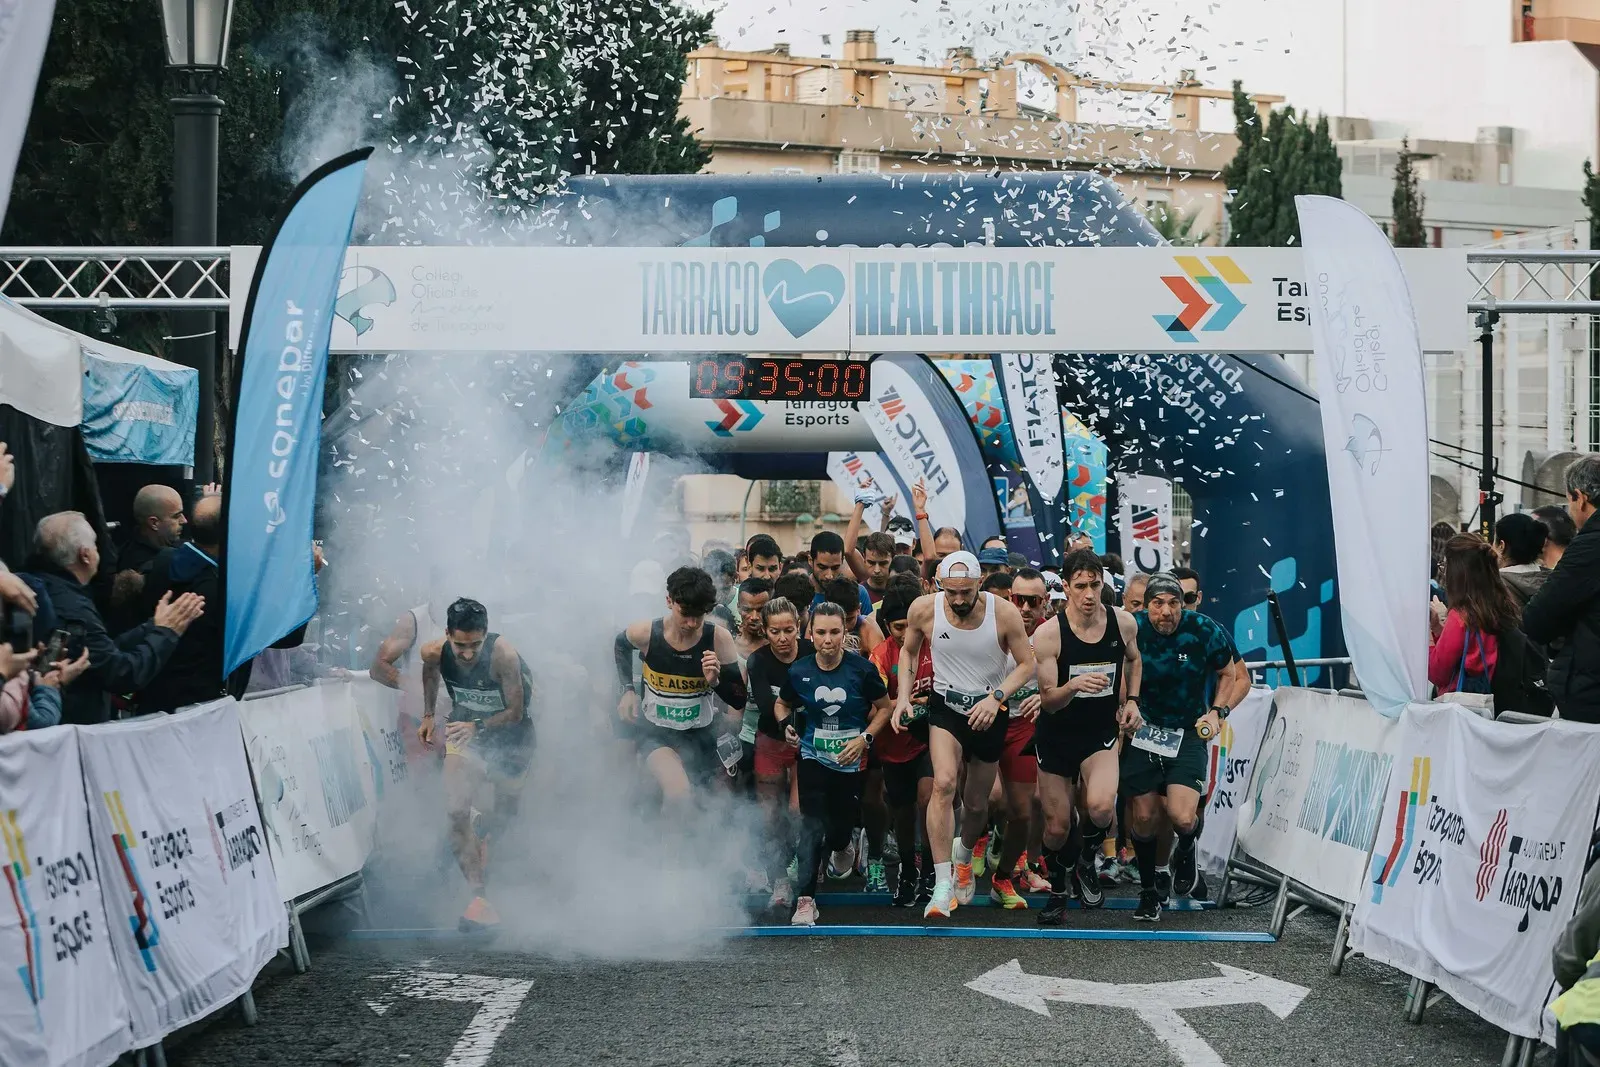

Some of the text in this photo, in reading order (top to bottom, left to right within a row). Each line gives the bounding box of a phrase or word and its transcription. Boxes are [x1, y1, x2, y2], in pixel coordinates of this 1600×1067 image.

[639, 260, 760, 336] TARRACO
[695, 361, 866, 398] 09:35:00
[1200, 354, 1244, 394] ud,
[269, 299, 304, 479] sonepar
[785, 399, 851, 411] Tarrago
[784, 412, 850, 428] Esports
[962, 695, 974, 706] 91
[665, 706, 693, 718] 1446
[1149, 727, 1168, 742] 123
[824, 738, 848, 750] 149
